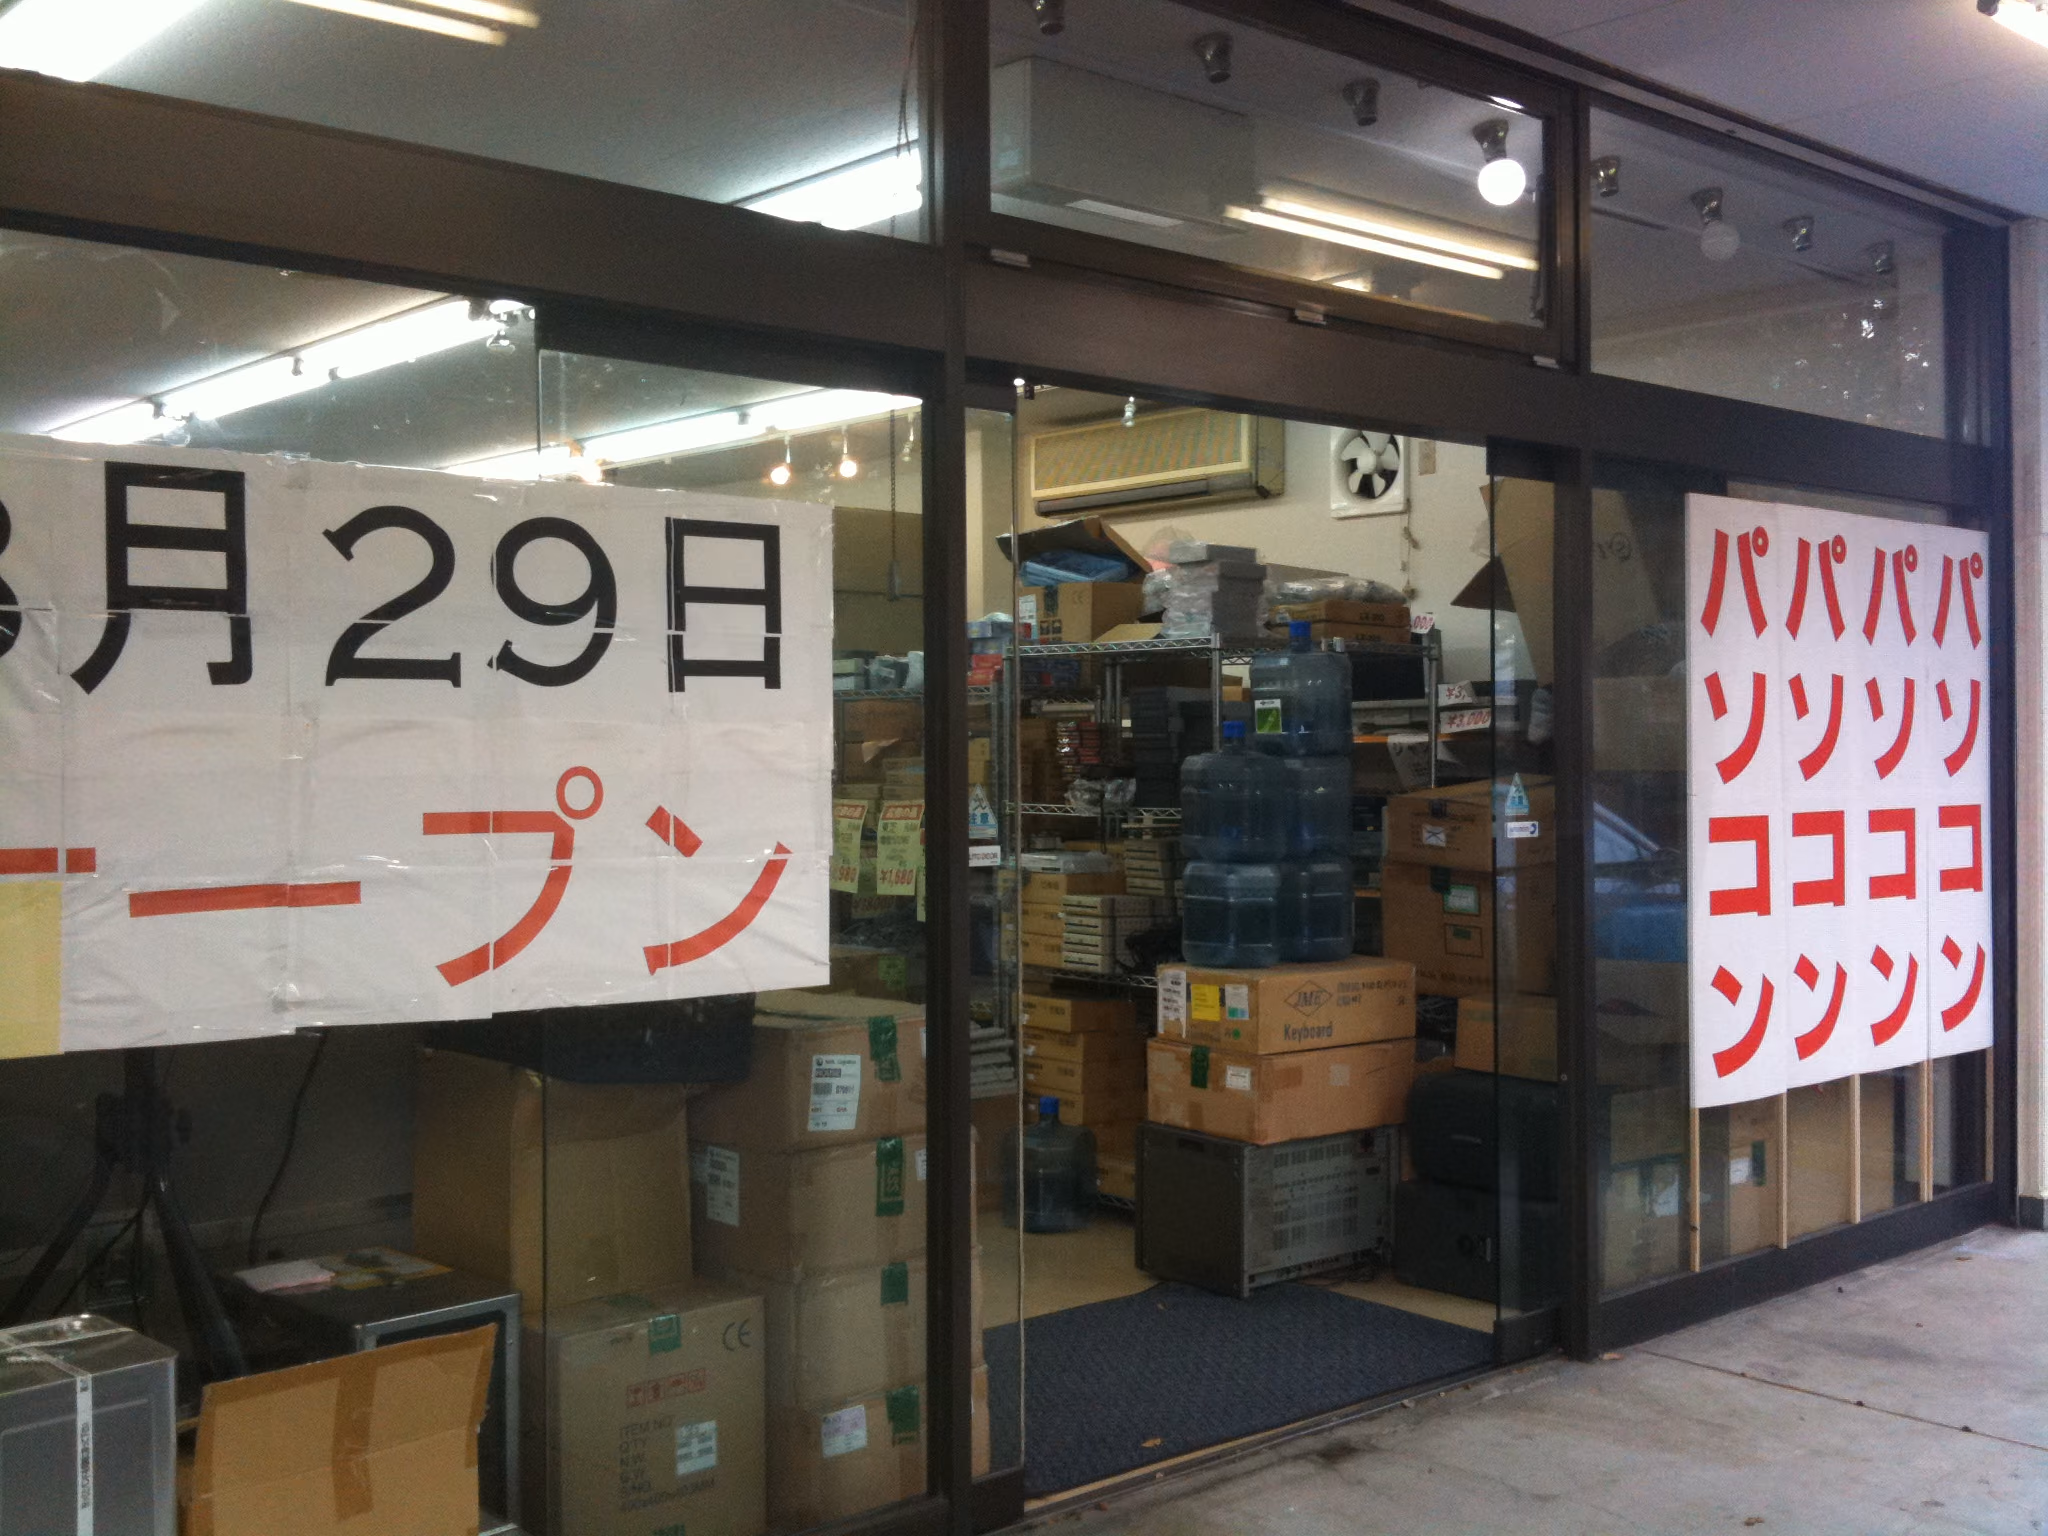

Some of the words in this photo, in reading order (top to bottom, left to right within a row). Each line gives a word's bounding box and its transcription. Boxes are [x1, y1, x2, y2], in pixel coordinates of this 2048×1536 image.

[0, 461, 782, 693] 月29日
[1700, 525, 1775, 1078] パソコン
[1785, 534, 1847, 1061] パソコン
[1862, 543, 1919, 1047] パソコン
[1931, 551, 1986, 1033] パソコン
[0, 766, 793, 987] ープン
[1284, 1021, 1333, 1042] Keyboard
